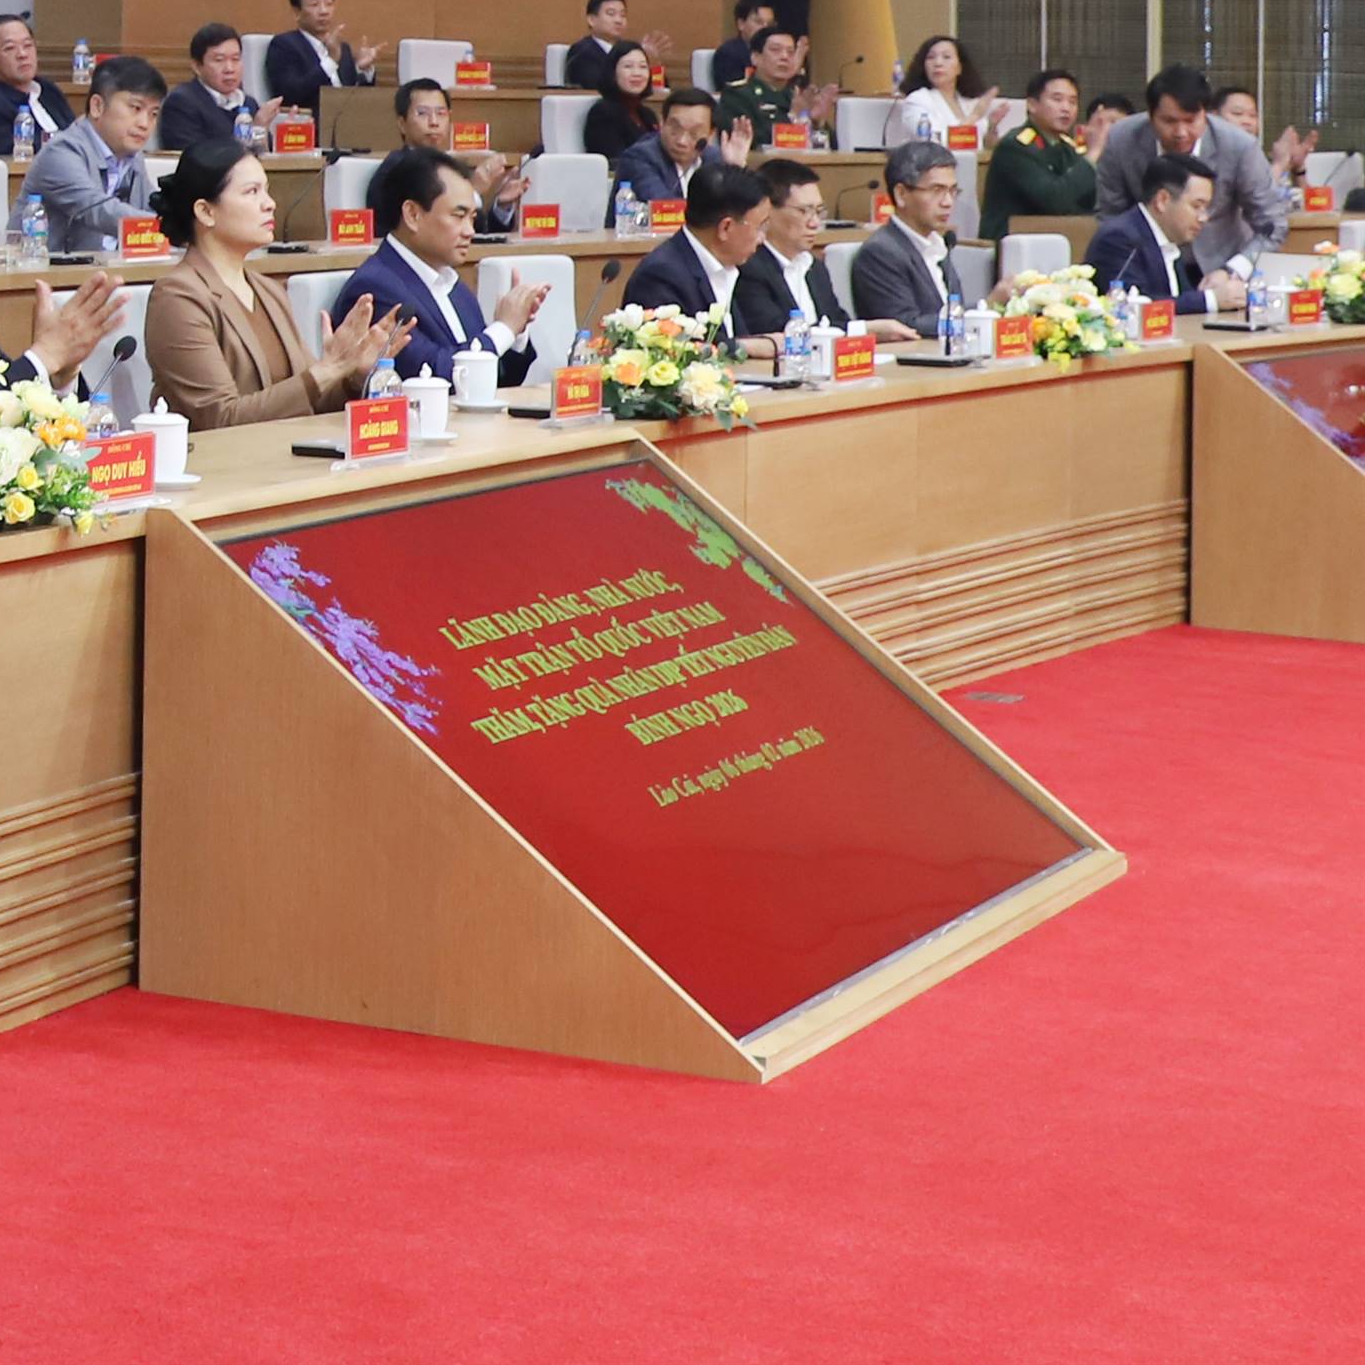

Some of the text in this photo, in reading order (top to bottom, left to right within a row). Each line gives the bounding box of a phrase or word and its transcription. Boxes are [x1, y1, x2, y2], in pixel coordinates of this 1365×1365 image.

[439, 616, 499, 650] LÃNH
[492, 606, 543, 637] ĐẠO
[583, 577, 632, 610] NHÀ
[472, 602, 725, 691] MẶT TRẬN TỔ QUỐC VIỆT NAM
[470, 707, 547, 743] THĂM,
[525, 695, 587, 728] TẶNG
[574, 676, 628, 714] QUÀ
[605, 666, 665, 698] NHÂN
[673, 644, 717, 678] TẾT
[701, 631, 767, 669] NGUYÊN
[757, 622, 797, 651] ĐÁN
[624, 688, 749, 746] BÍNH NGỌ 2026
